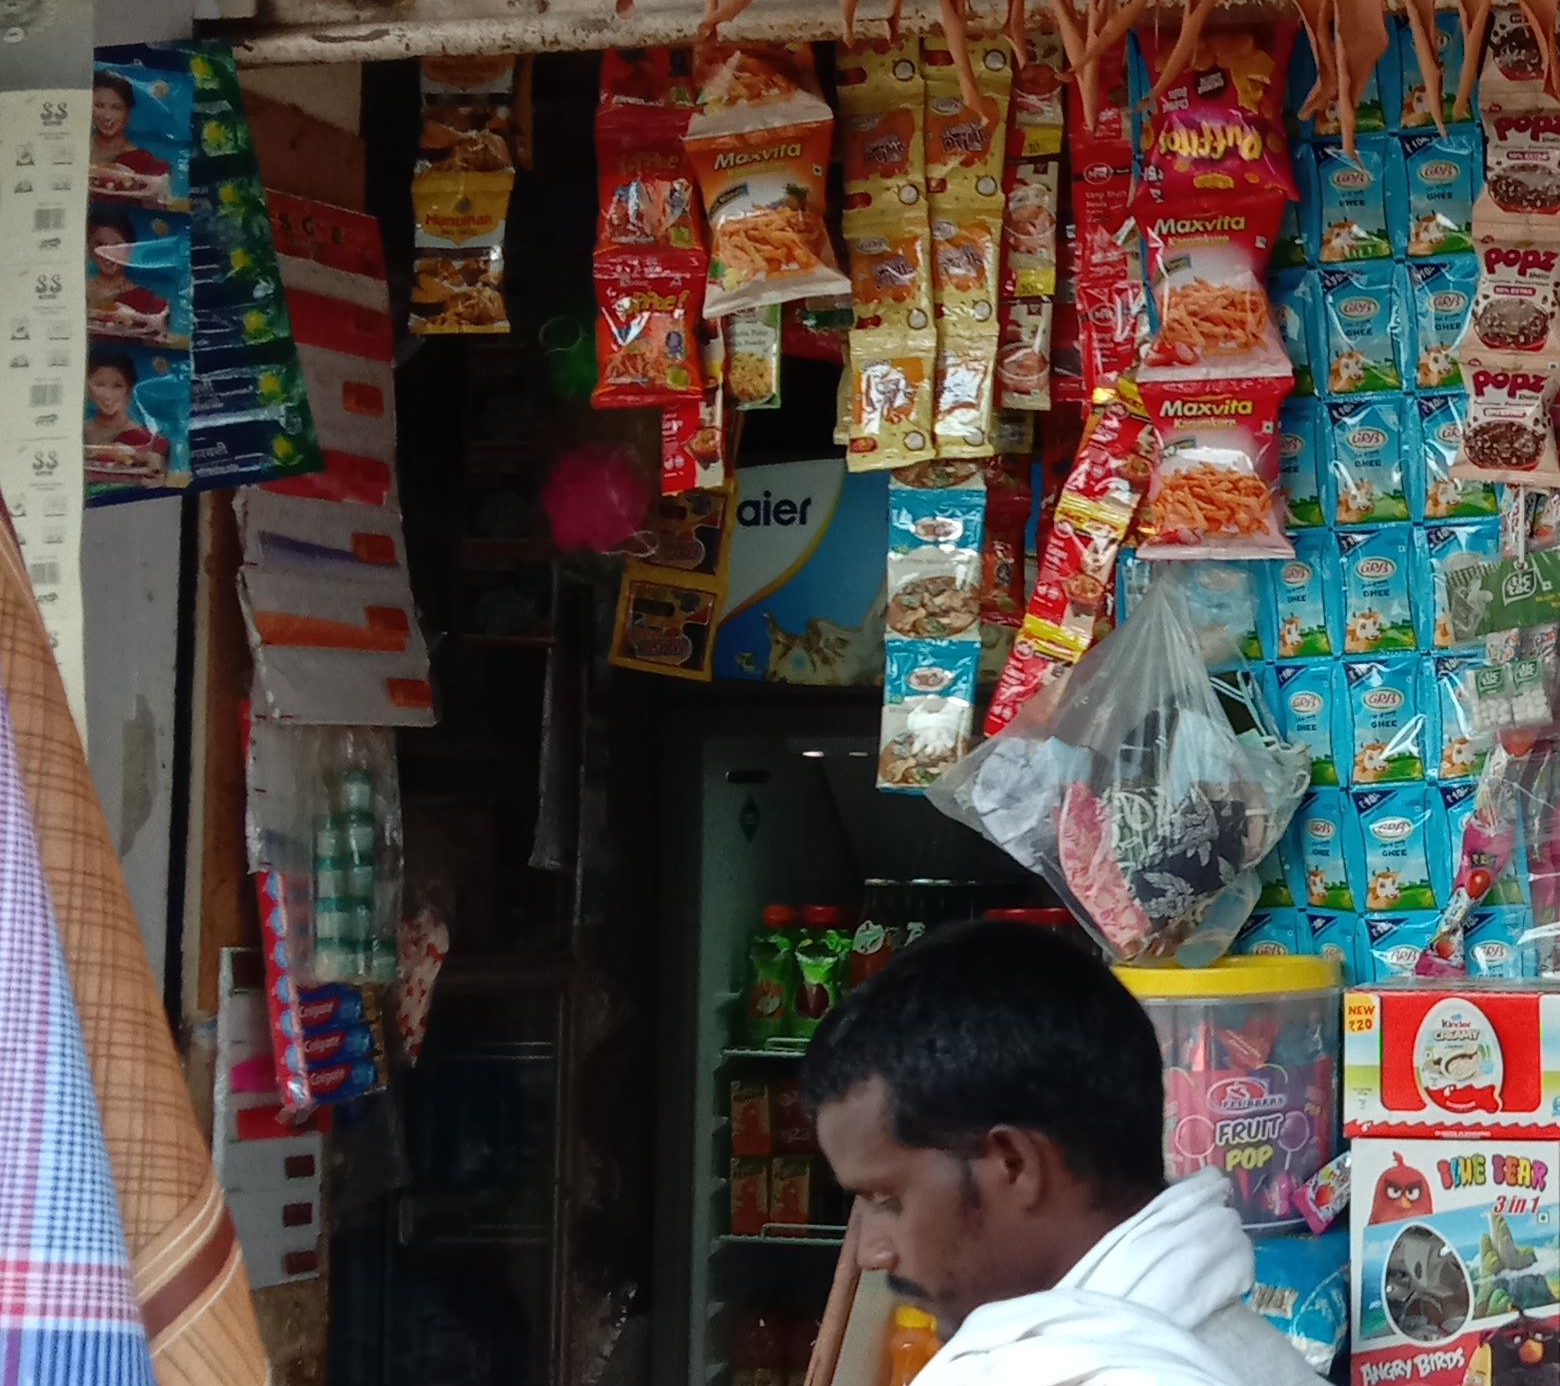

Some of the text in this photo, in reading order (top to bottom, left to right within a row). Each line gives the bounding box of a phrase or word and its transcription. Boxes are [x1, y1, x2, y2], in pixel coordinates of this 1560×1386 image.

[734, 494, 813, 528] aier
[300, 1001, 334, 1018] Colgate
[1348, 1006, 1375, 1015] NEW
[304, 1036, 340, 1052] Colgate
[1433, 1029, 1481, 1042] CREAMY
[1215, 1114, 1285, 1146] FRUIT
[1225, 1145, 1274, 1172] POP
[1494, 1194, 1541, 1213] 3 in 1
[1416, 1346, 1465, 1377] BIRDS
